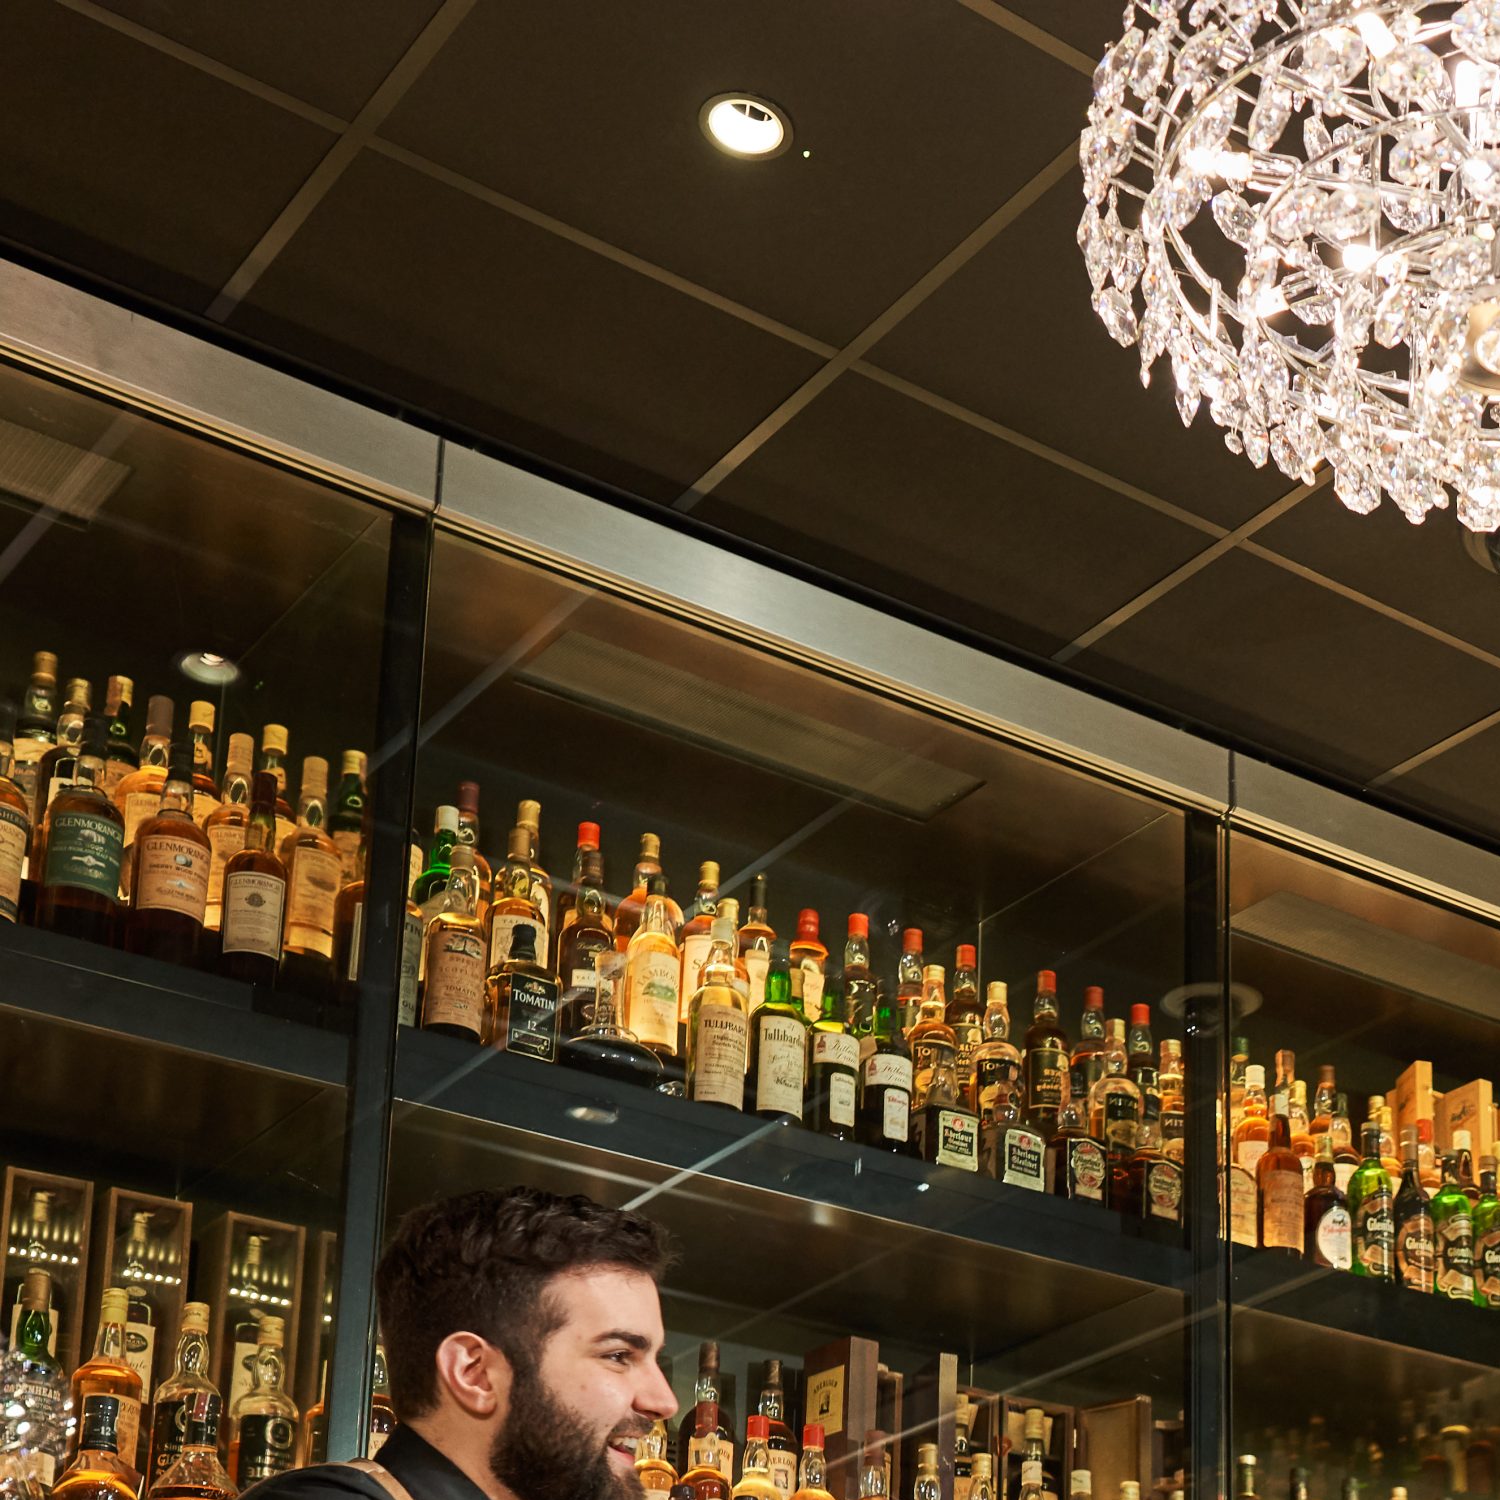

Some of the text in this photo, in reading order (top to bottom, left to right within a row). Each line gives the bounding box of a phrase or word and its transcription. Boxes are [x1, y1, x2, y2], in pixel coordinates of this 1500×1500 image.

[512, 988, 556, 1011] TOMATIN
[527, 1019, 537, 1031] 12
[100, 1426, 111, 1436] 12
